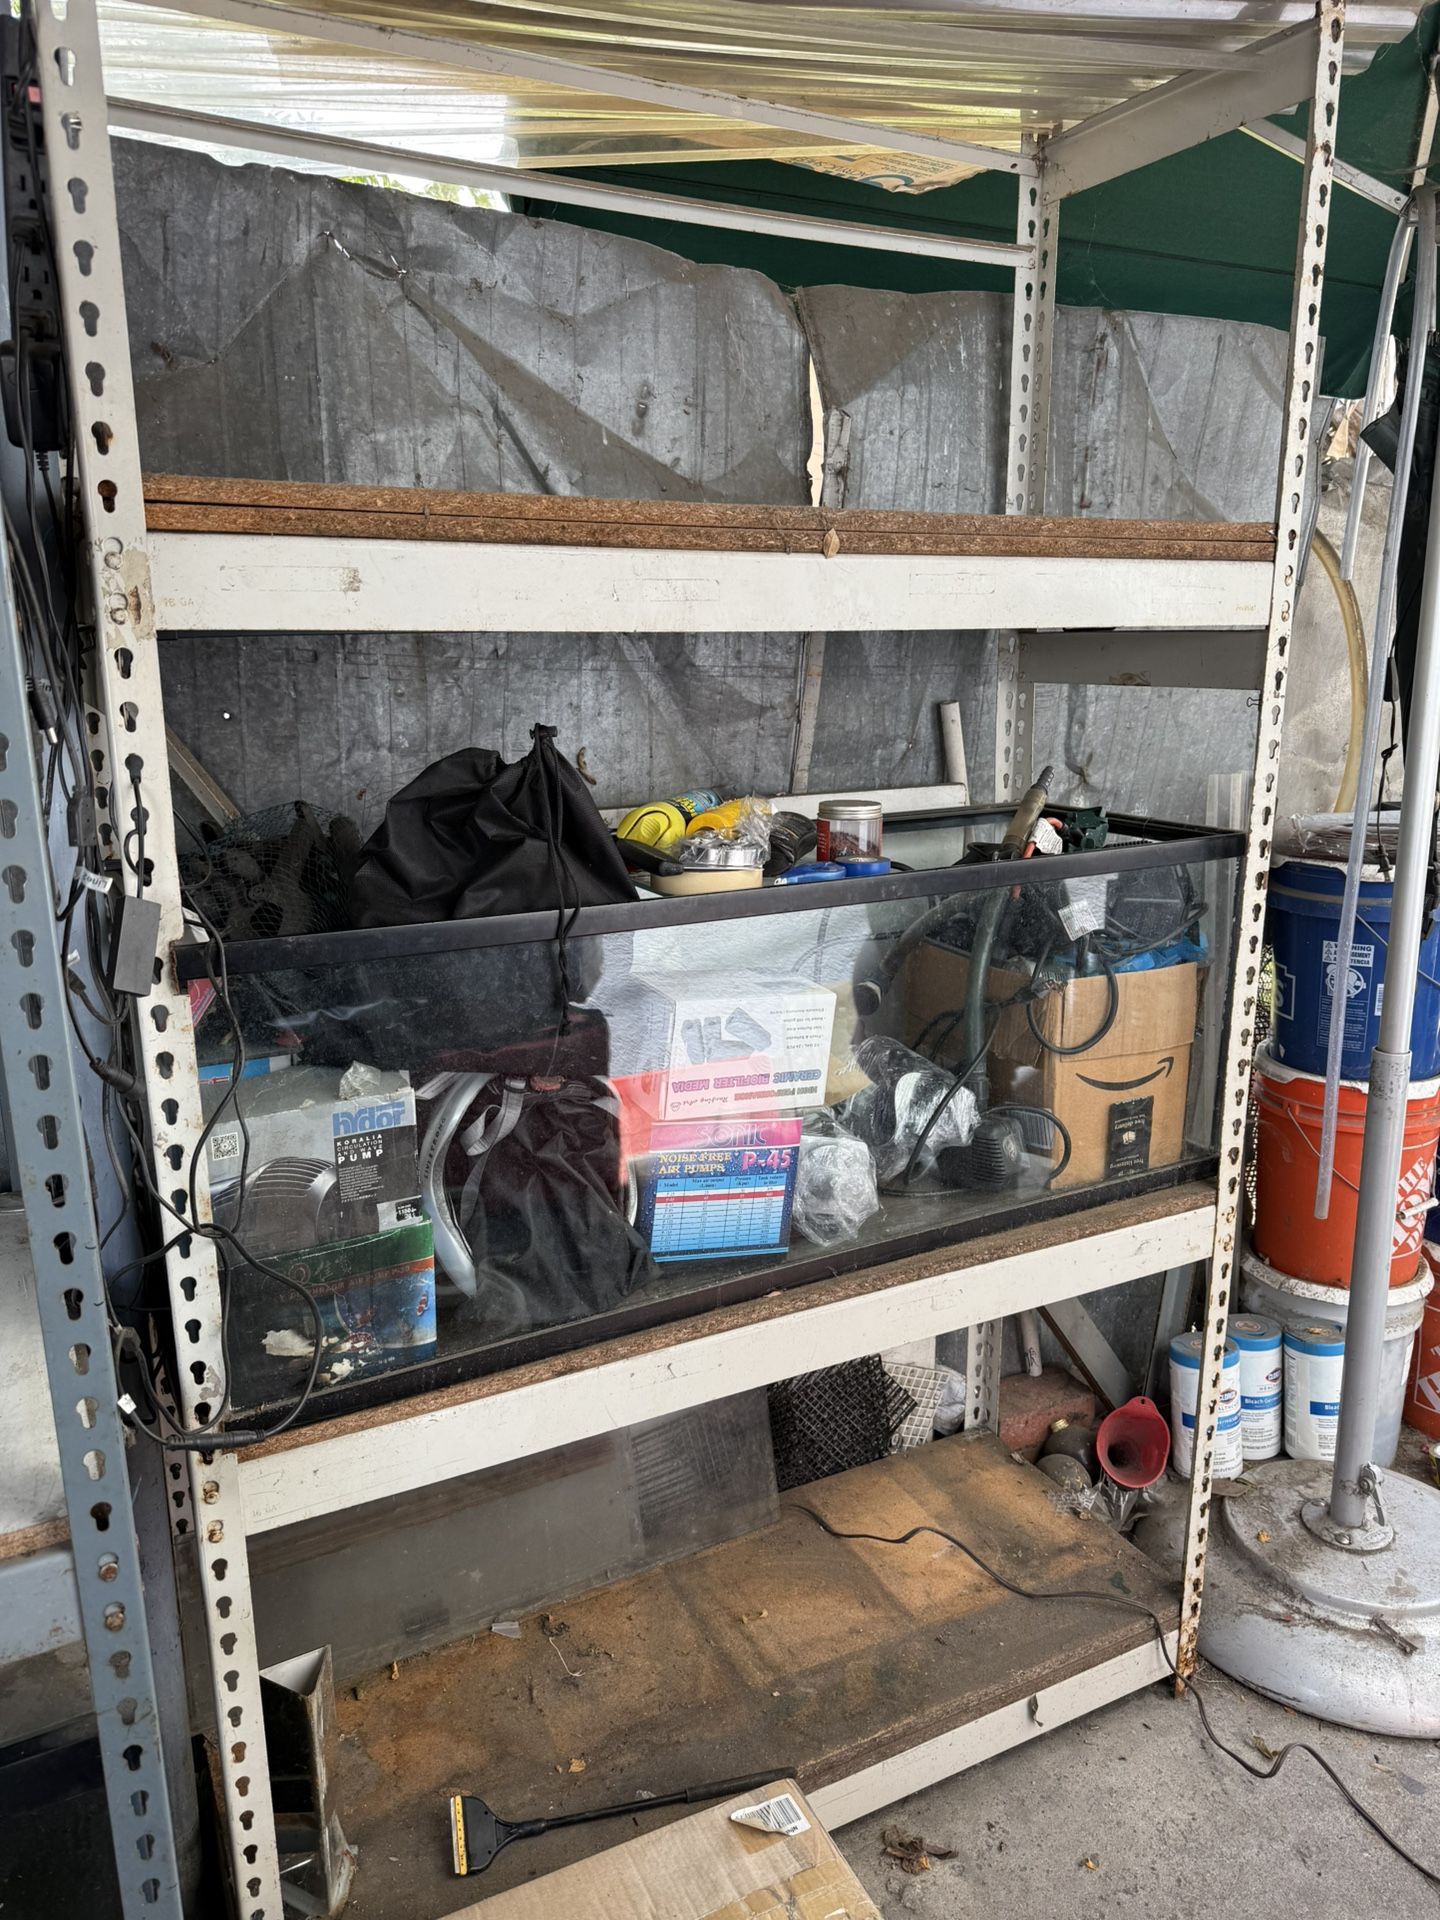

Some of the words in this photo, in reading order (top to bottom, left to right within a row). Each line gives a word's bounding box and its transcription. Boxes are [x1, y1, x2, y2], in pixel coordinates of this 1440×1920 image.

[714, 1073, 771, 1089] BIOFILTER
[773, 1068, 822, 1085] CERAMIC
[672, 1078, 710, 1093] MEDIA
[336, 1133, 383, 1147] KORALIA
[336, 1139, 383, 1152] CIRCULATION
[337, 1149, 355, 1157] AND
[360, 1144, 383, 1152] WAVE
[338, 1149, 384, 1165] PUMP
[741, 1149, 792, 1171] P-45
[658, 1163, 681, 1175] AIR
[684, 1162, 726, 1175] PUMPS
